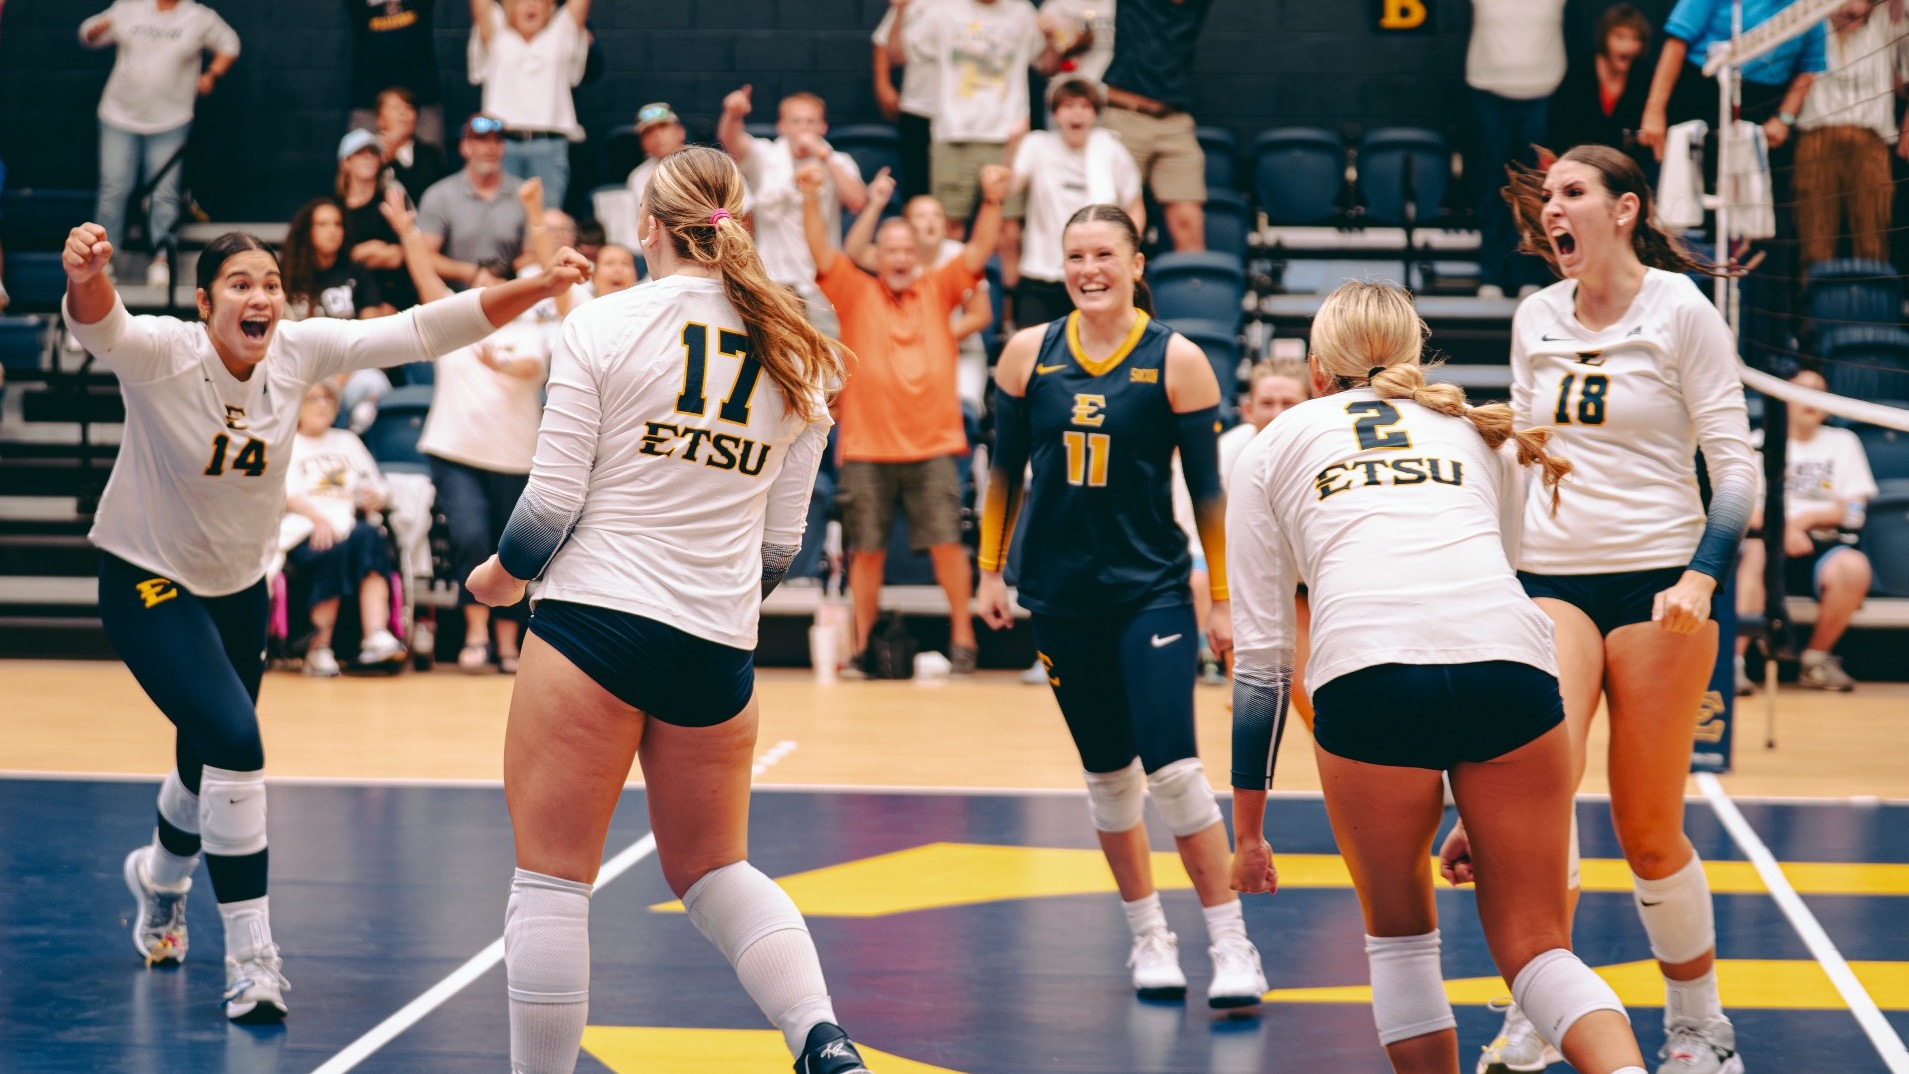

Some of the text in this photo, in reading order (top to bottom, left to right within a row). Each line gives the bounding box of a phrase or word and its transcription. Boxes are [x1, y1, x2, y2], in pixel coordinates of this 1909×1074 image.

[674, 320, 764, 427] 17
[1554, 371, 1612, 426] 18
[1071, 393, 1106, 427] E
[1344, 400, 1412, 450] 2
[202, 431, 268, 477] 14
[638, 420, 773, 478] ETSU
[1063, 430, 1111, 487] 11
[1314, 457, 1464, 502] ETSU
